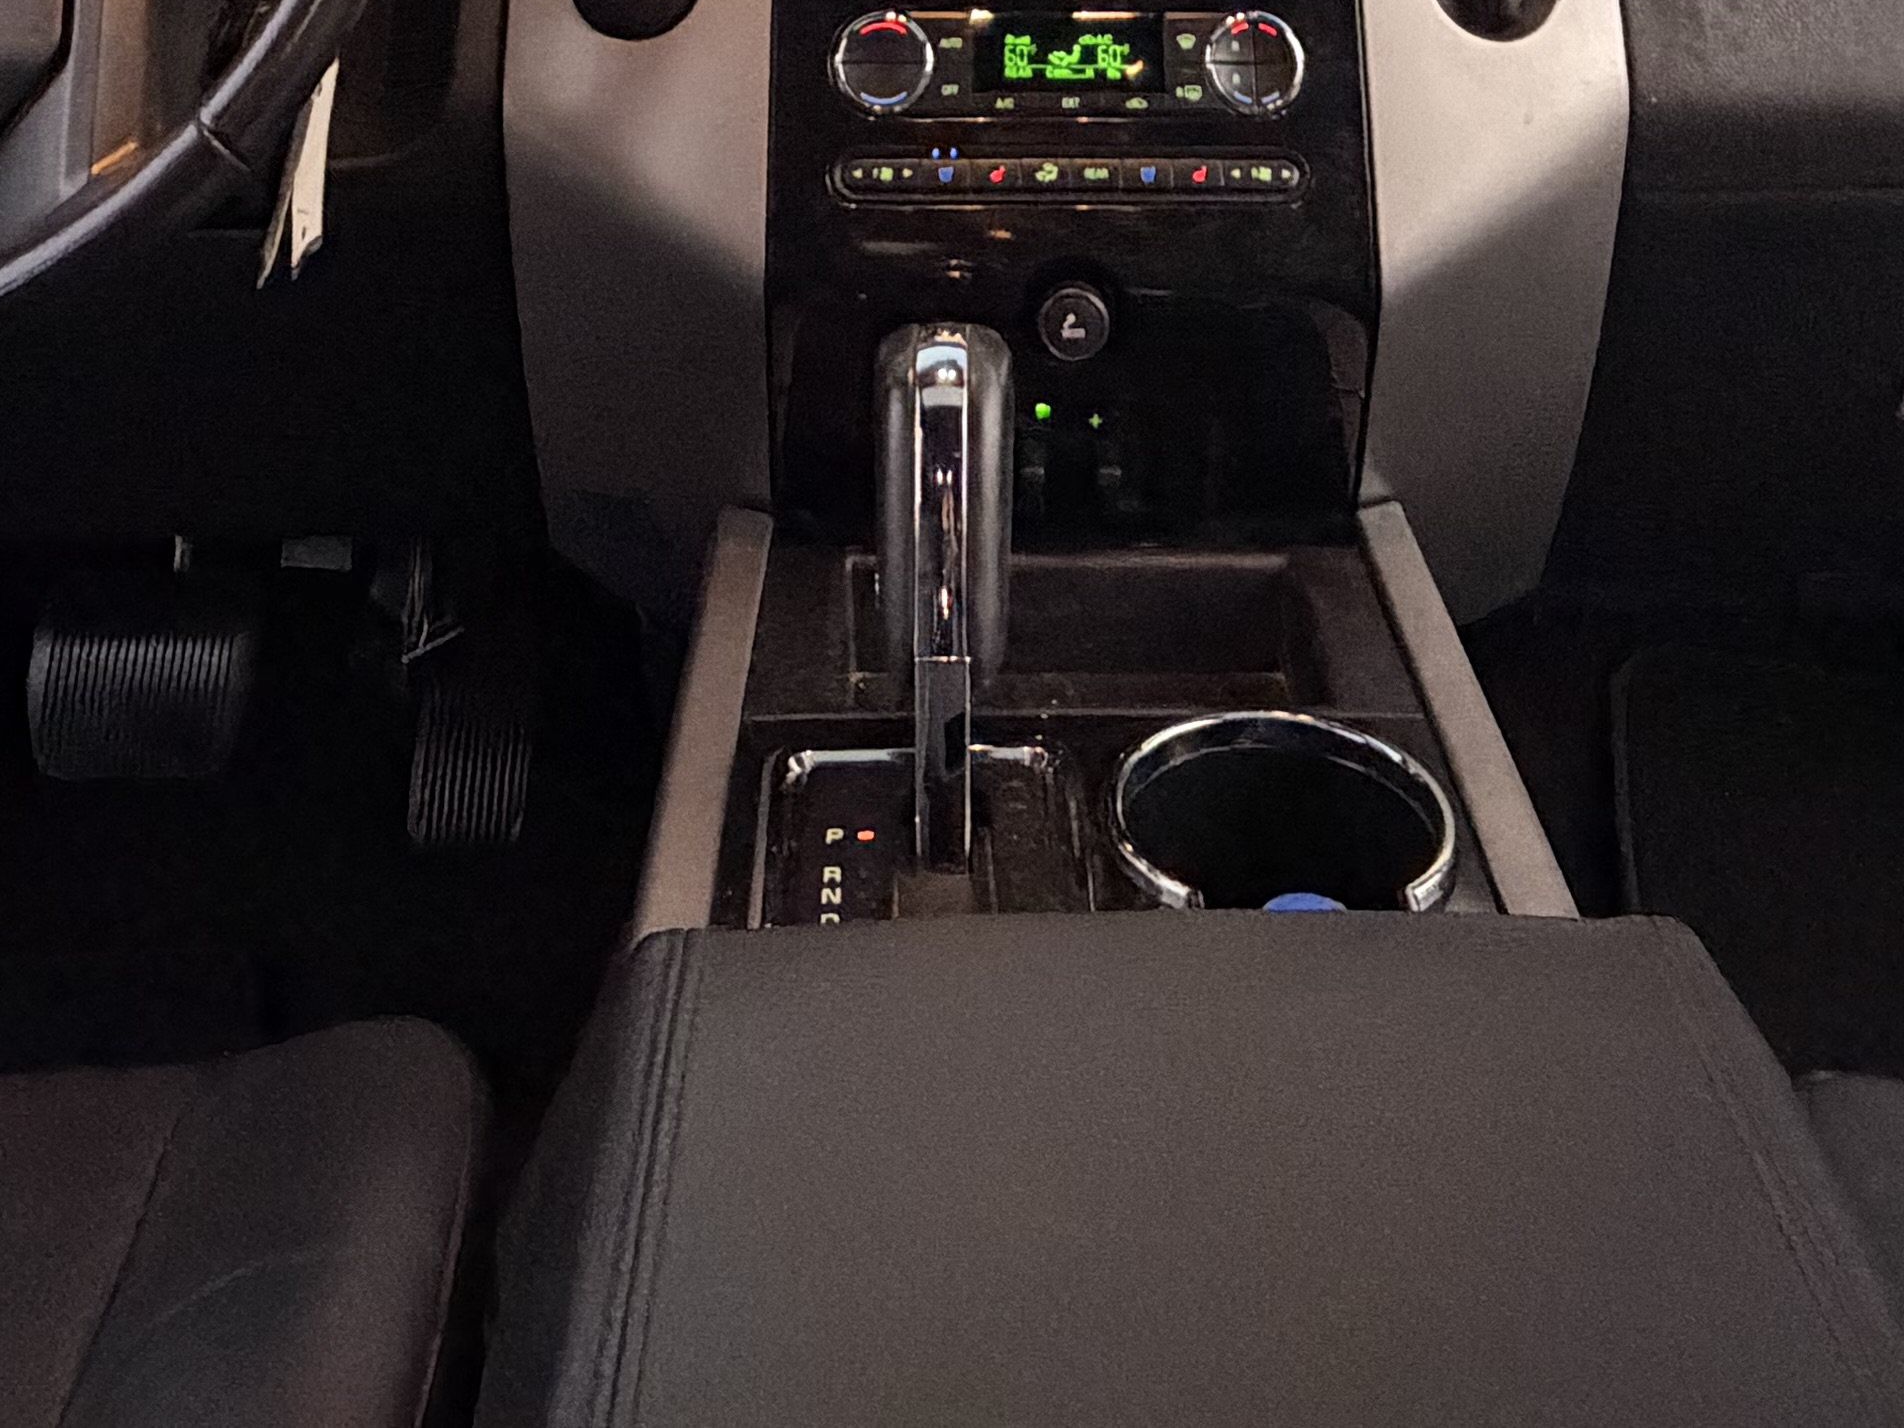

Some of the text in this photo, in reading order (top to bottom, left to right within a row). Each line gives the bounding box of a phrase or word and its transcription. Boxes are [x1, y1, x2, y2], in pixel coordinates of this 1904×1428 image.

[825, 827, 844, 845] P
[823, 866, 842, 883] R
[821, 887, 842, 904] N
